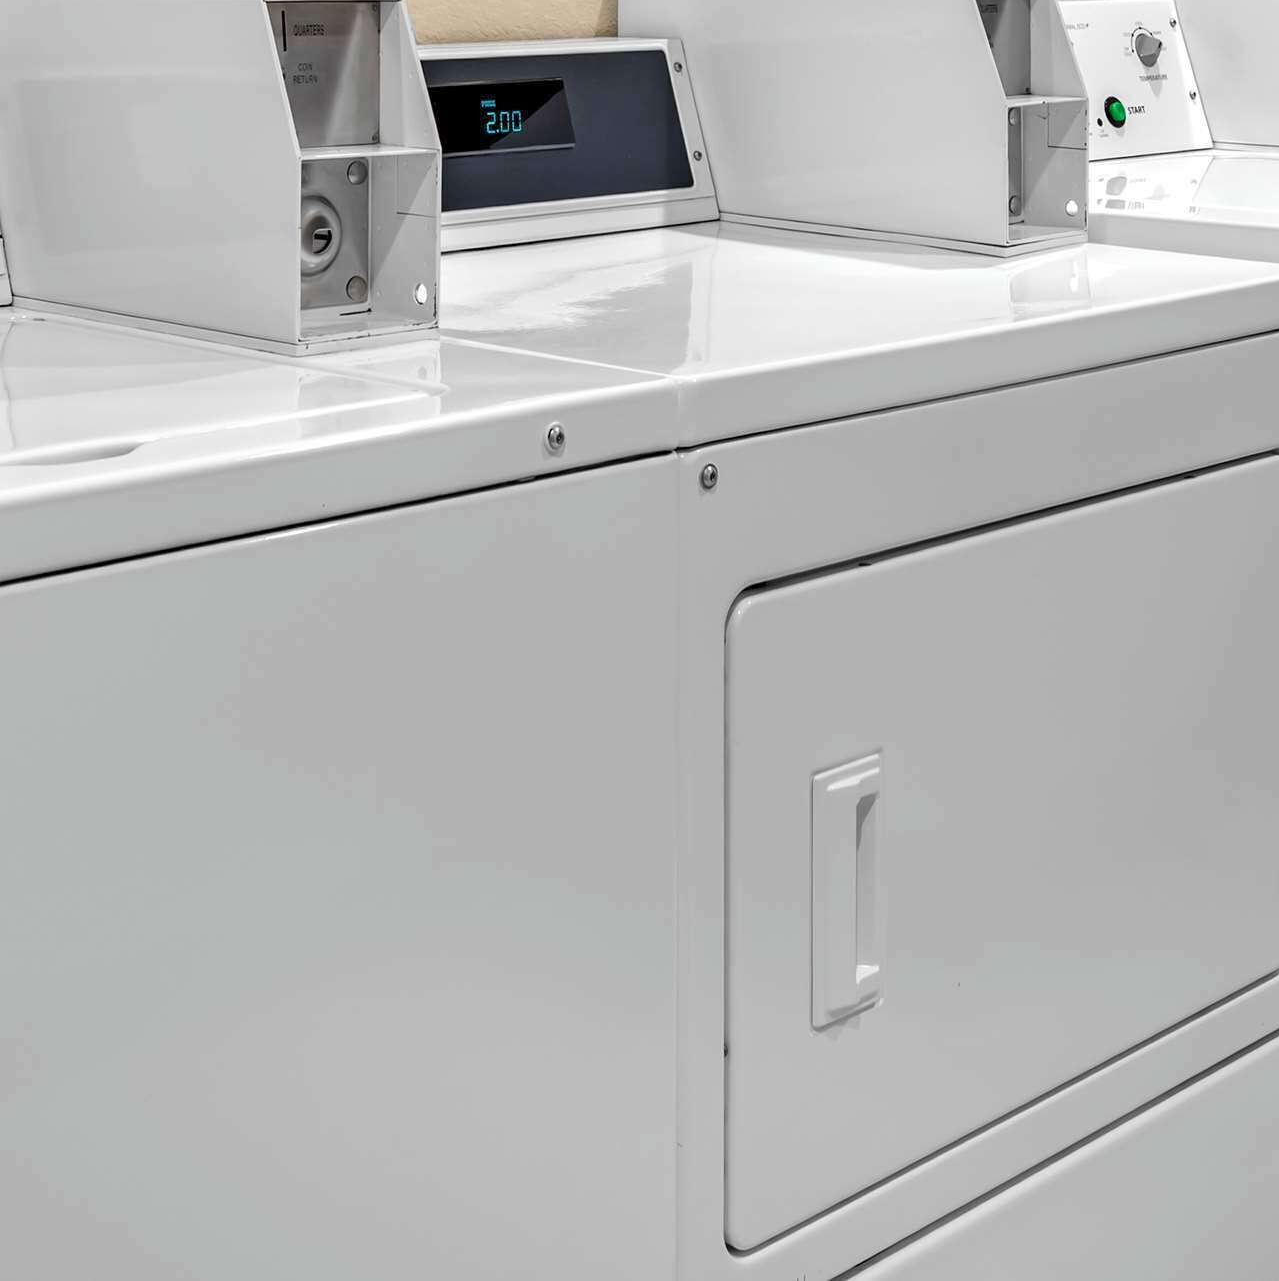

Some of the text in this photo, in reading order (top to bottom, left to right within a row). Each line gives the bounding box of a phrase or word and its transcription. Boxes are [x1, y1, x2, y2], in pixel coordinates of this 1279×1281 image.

[297, 63, 313, 72] COIN
[292, 74, 318, 84] RETURN
[1127, 105, 1146, 115] START
[486, 110, 522, 134] 2.00
